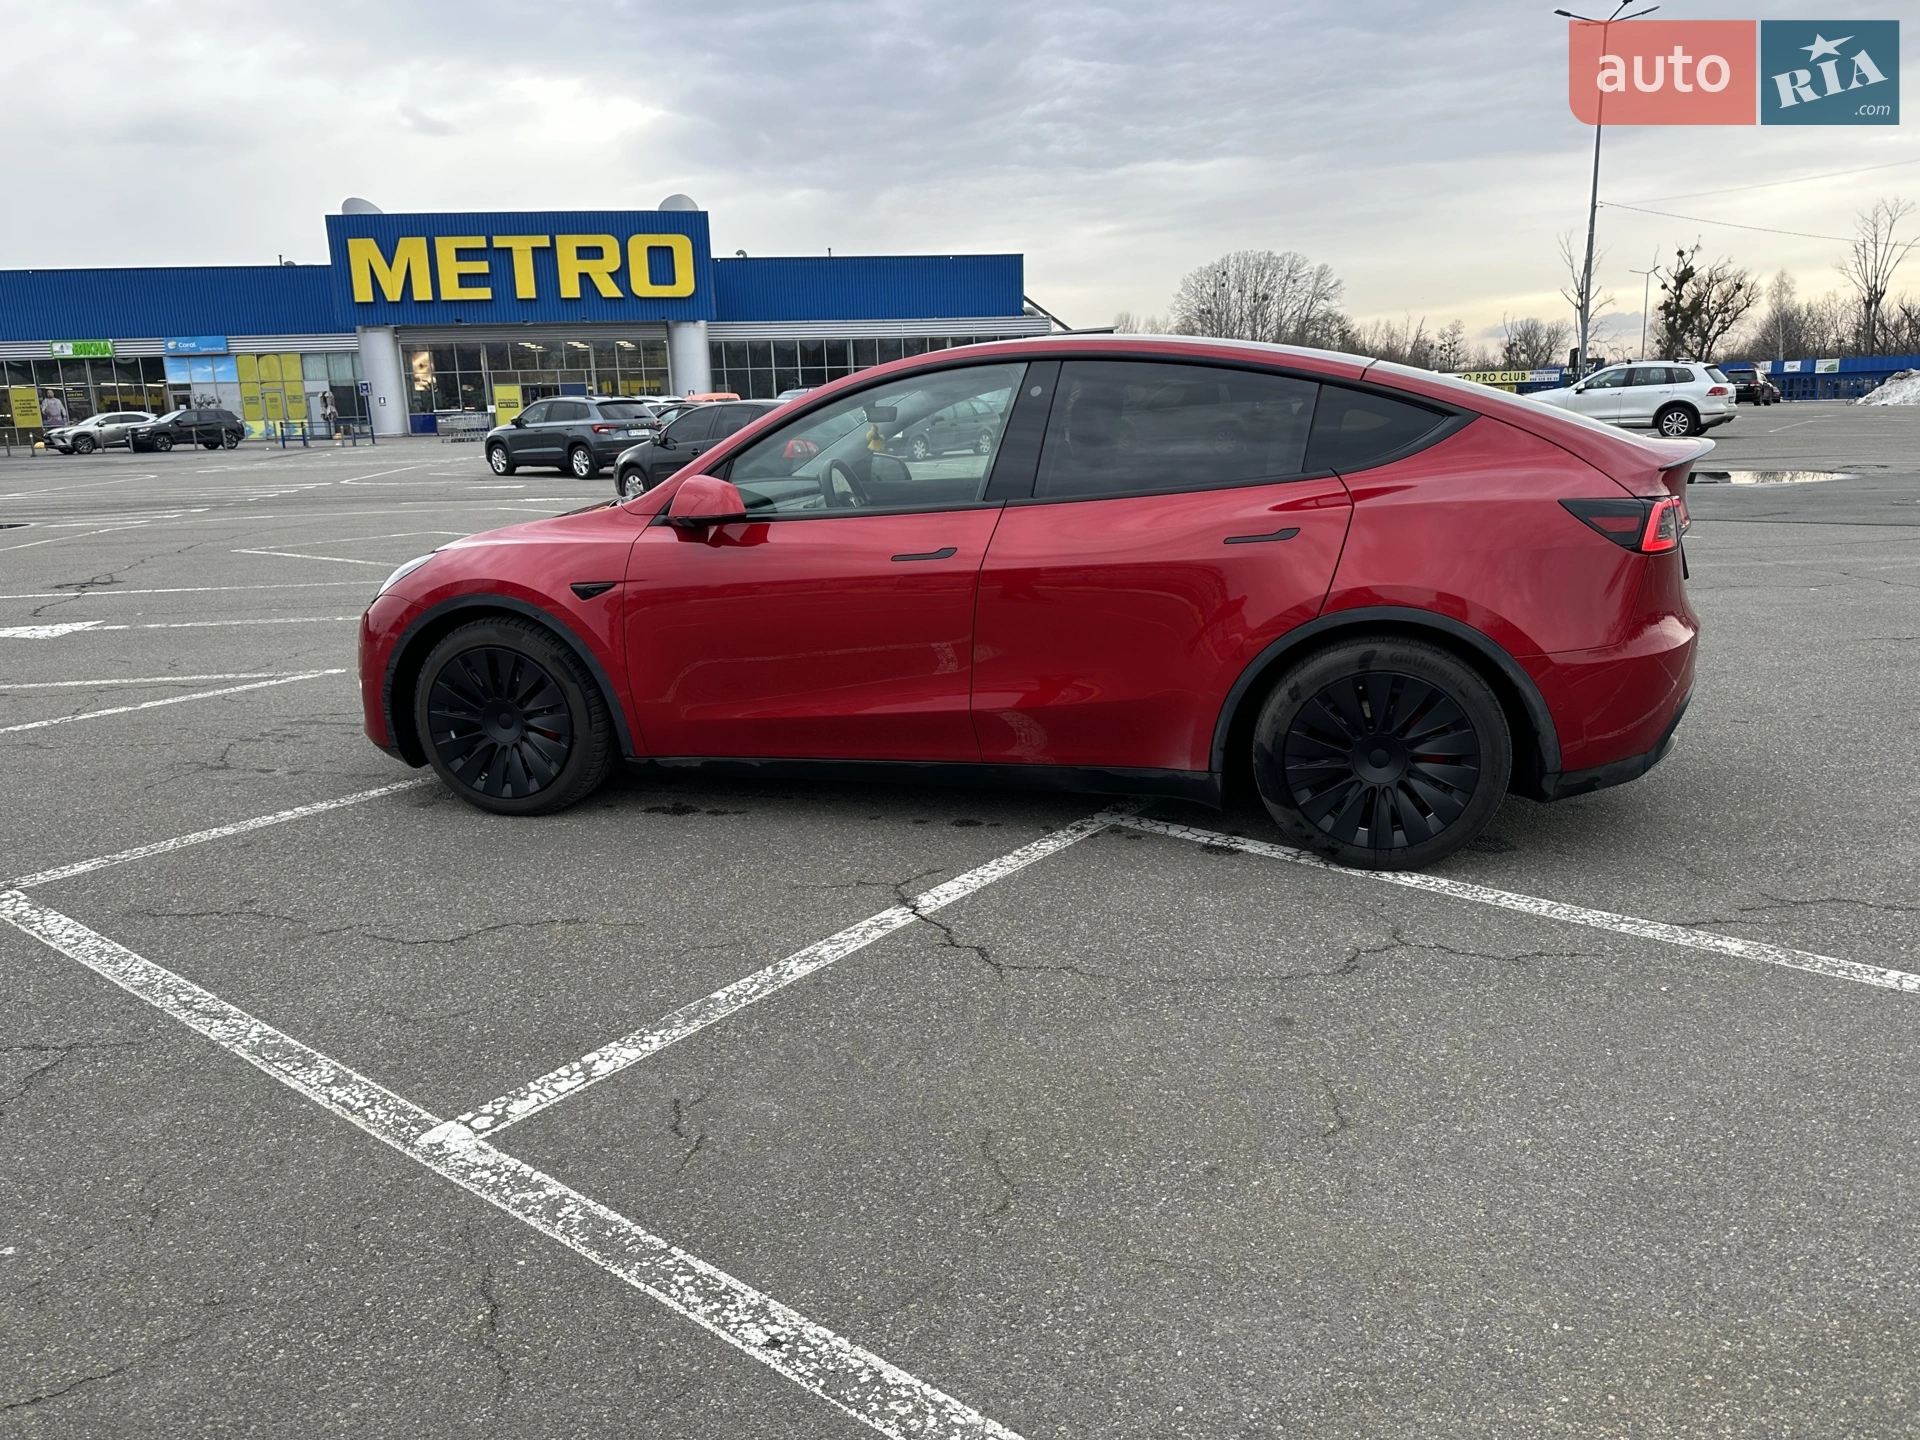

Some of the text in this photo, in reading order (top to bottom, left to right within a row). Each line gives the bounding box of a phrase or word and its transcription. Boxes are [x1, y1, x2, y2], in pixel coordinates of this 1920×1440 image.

[347, 233, 696, 303] METRO
[73, 342, 112, 356] ВІКНА
[178, 341, 197, 349] Coral
[1475, 372, 1497, 383] PRO
[1500, 371, 1527, 382] CLUB
